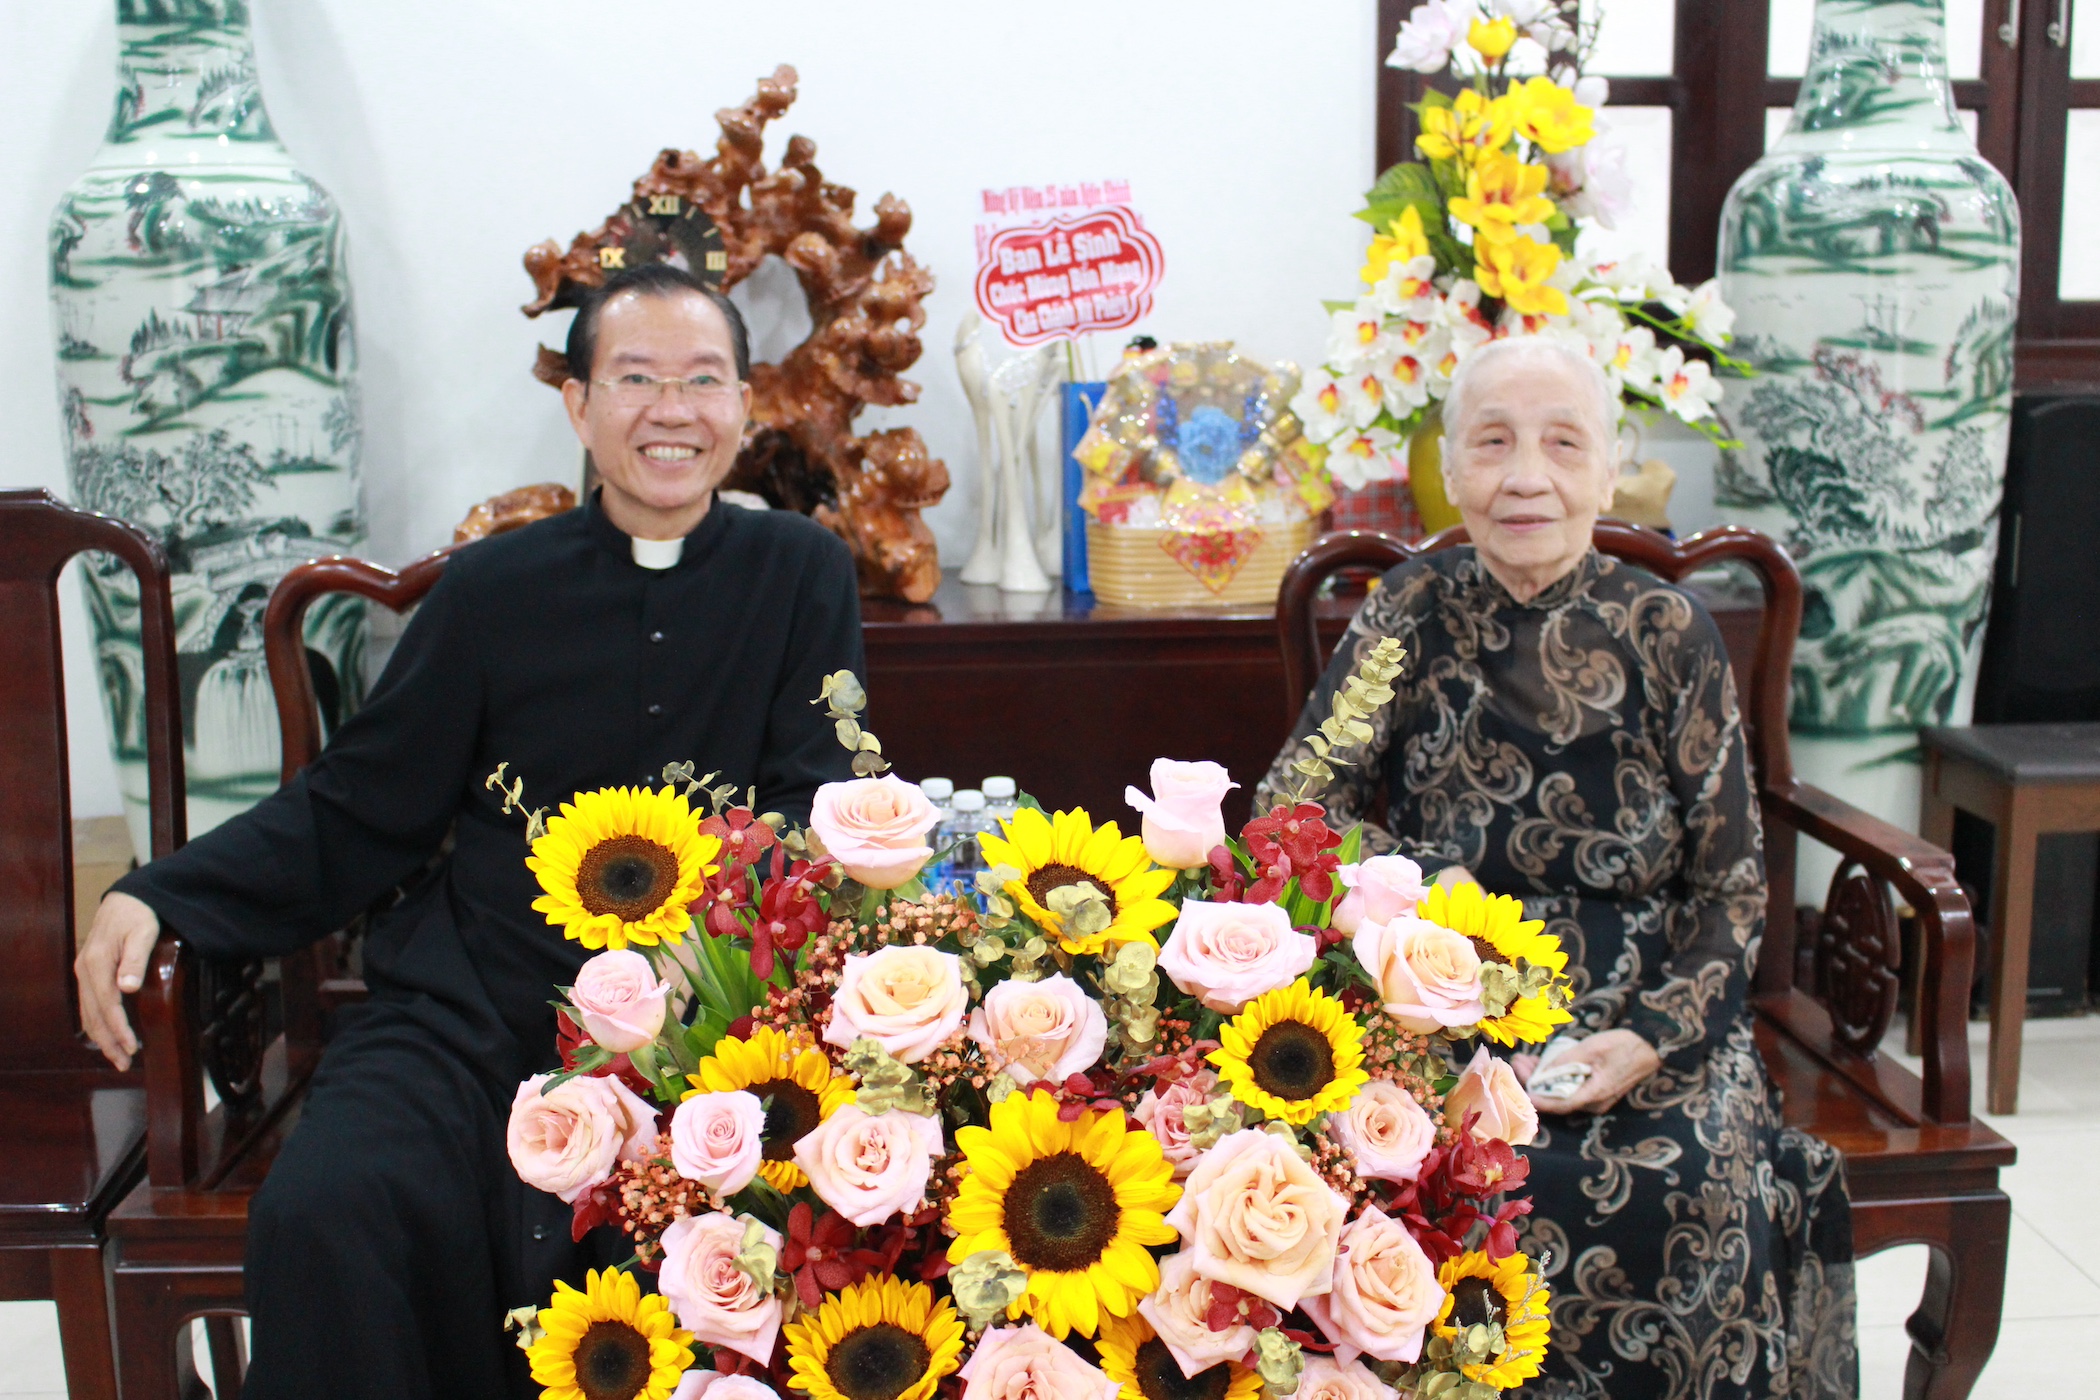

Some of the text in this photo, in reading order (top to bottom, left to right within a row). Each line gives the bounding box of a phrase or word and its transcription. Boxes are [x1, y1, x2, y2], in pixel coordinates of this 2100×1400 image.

[647, 195, 681, 215] XII
[600, 247, 626, 268] IX
[705, 251, 728, 271] III
[1000, 247, 1042, 276] Ban
[1072, 228, 1122, 263] Sinh
[989, 279, 1027, 308] Chúc
